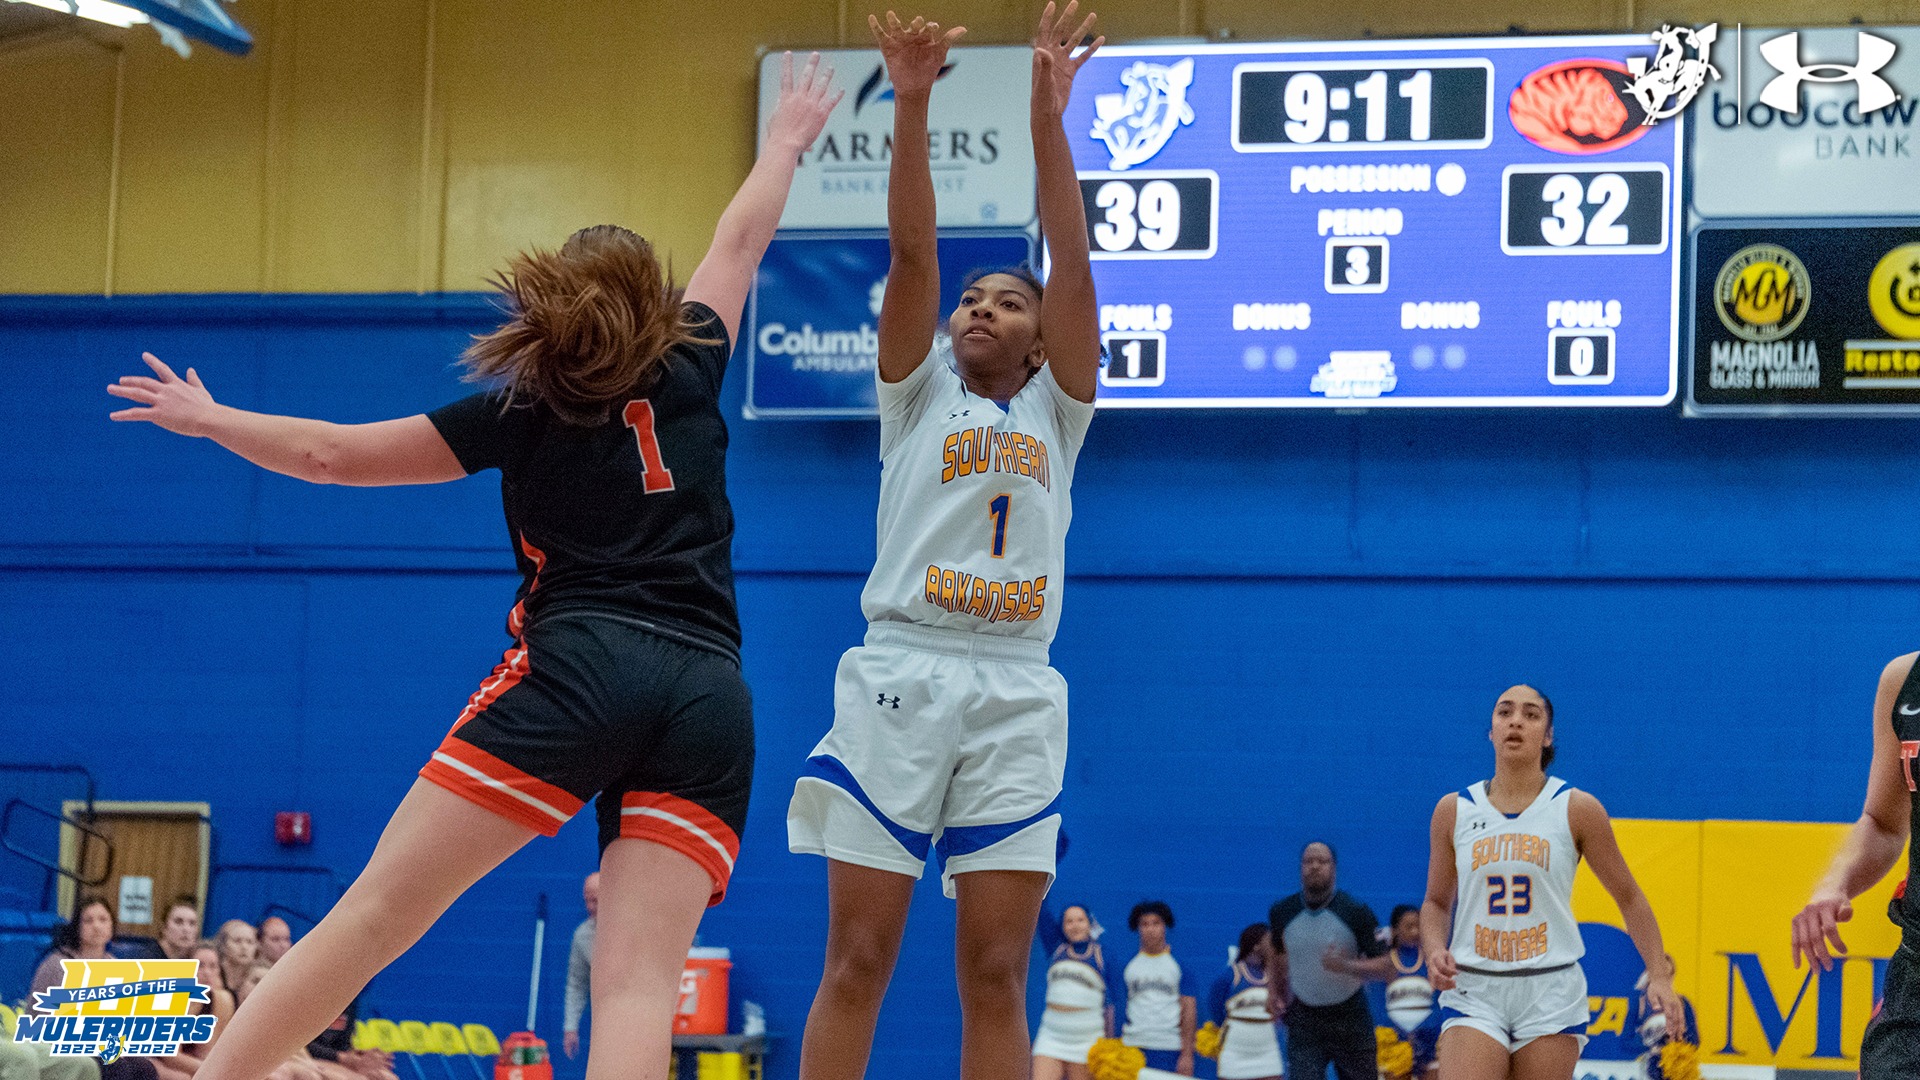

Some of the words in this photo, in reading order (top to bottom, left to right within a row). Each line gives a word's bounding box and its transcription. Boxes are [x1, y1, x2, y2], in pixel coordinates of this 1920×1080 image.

[1283, 70, 1431, 143] 9:11
[796, 128, 998, 167] ARERS
[1816, 133, 1911, 159] BANK
[1290, 164, 1431, 193] POSSESSION
[1094, 180, 1181, 252] 39
[1317, 208, 1403, 236] PERIOD
[1540, 173, 1631, 247] 32
[1344, 247, 1370, 286] 3
[1100, 303, 1172, 332] FOULS
[1232, 302, 1311, 330] BONUS
[1400, 301, 1480, 329] BONUS
[1546, 299, 1621, 328] FOULS
[1121, 341, 1141, 379] 1
[1569, 337, 1594, 377] 0
[1711, 340, 1819, 371] MAGNOLIA
[1710, 370, 1753, 388] GLASS
[1768, 370, 1820, 388] MIRROR
[622, 399, 675, 494] 1
[941, 426, 1051, 493] SOUTHERN
[987, 493, 1012, 560] 1
[925, 564, 1048, 623] ARKANSAS
[1471, 833, 1550, 872] SOUTHERN
[1486, 874, 1533, 917] 23
[1475, 922, 1548, 963] ARKANSAS
[1713, 951, 1893, 1060] M
